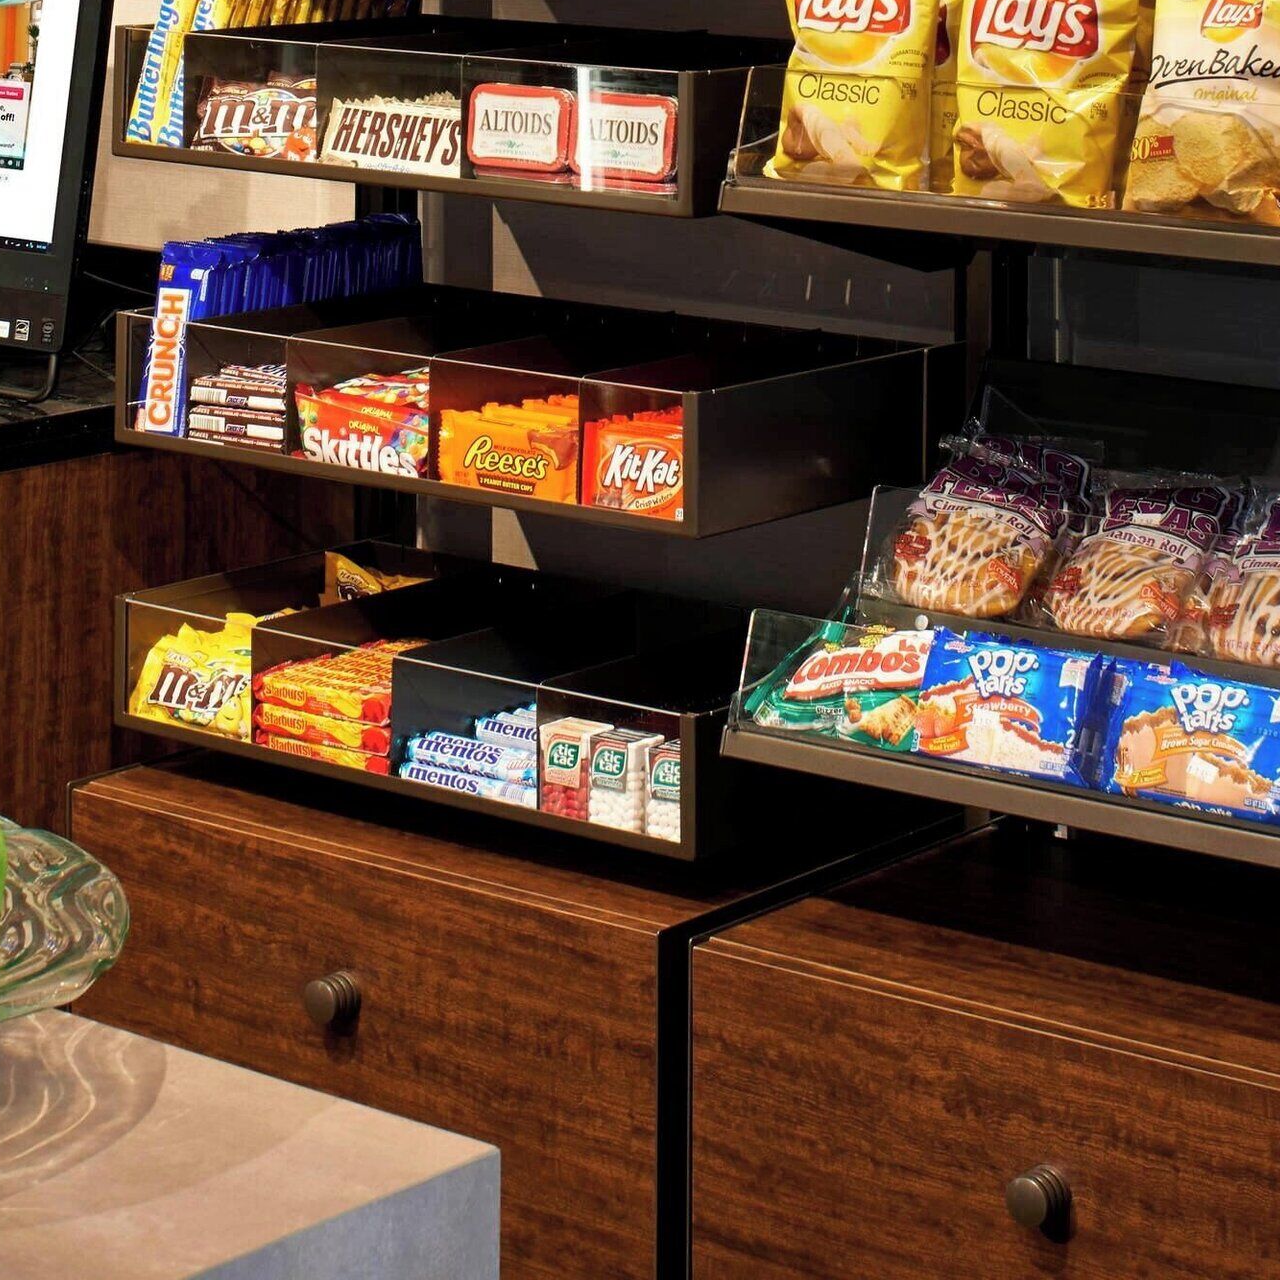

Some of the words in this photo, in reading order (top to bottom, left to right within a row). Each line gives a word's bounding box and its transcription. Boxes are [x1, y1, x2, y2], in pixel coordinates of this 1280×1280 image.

[797, 75, 881, 105] Classic
[1193, 87, 1259, 103] Original
[1, 113, 15, 121] off!
[976, 91, 1069, 125] Classic
[479, 109, 554, 136] ALTOIDS
[332, 107, 461, 167] HERSHEY'S
[148, 293, 184, 426] CRUNCH
[302, 428, 418, 477] Skittles
[964, 700, 1030, 716] Strawberry
[417, 739, 502, 766] mentos
[551, 754, 574, 767] tac
[558, 744, 576, 756] tic
[605, 751, 621, 763] tic
[408, 766, 480, 794] mentos
[599, 760, 621, 773] tac
